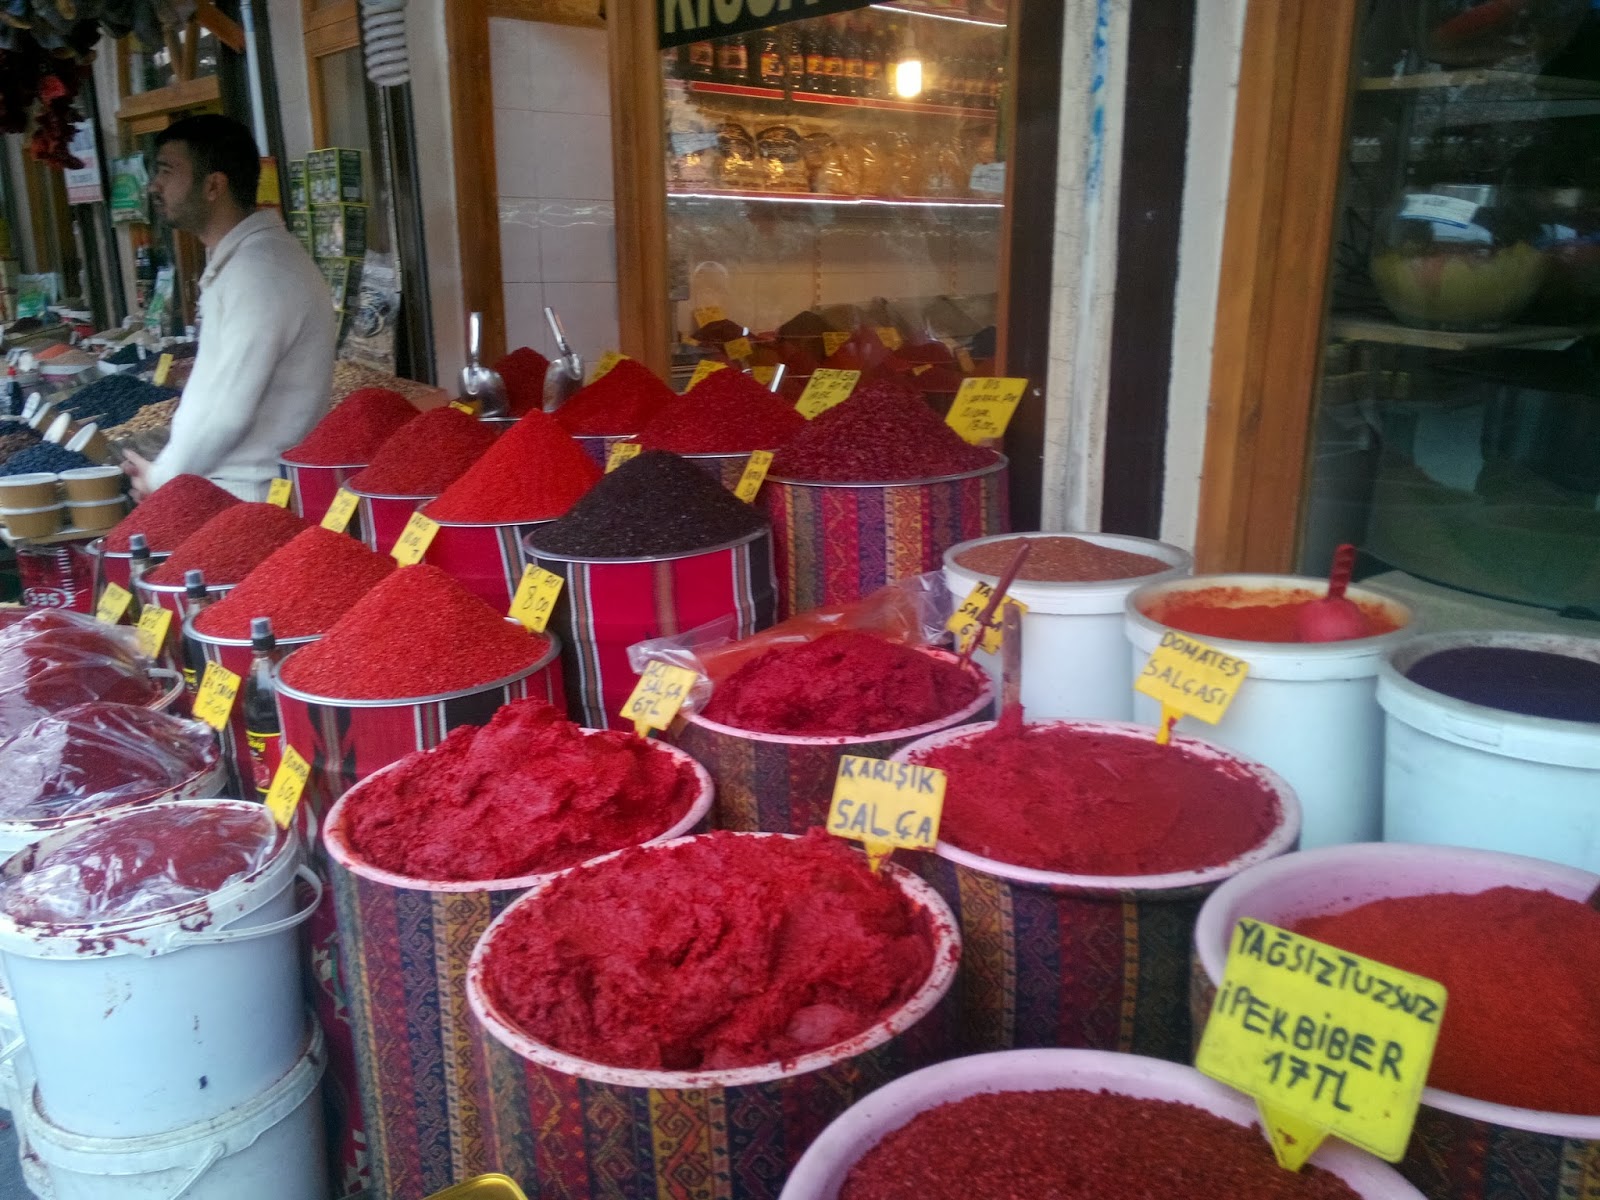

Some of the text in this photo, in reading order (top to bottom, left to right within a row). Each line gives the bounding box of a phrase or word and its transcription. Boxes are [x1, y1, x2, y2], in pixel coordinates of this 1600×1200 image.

[1159, 631, 1247, 677] DOMATES
[841, 757, 935, 794] KARIŞIK
[833, 798, 932, 843] SALÇA
[1263, 1051, 1353, 1113] 17TL
